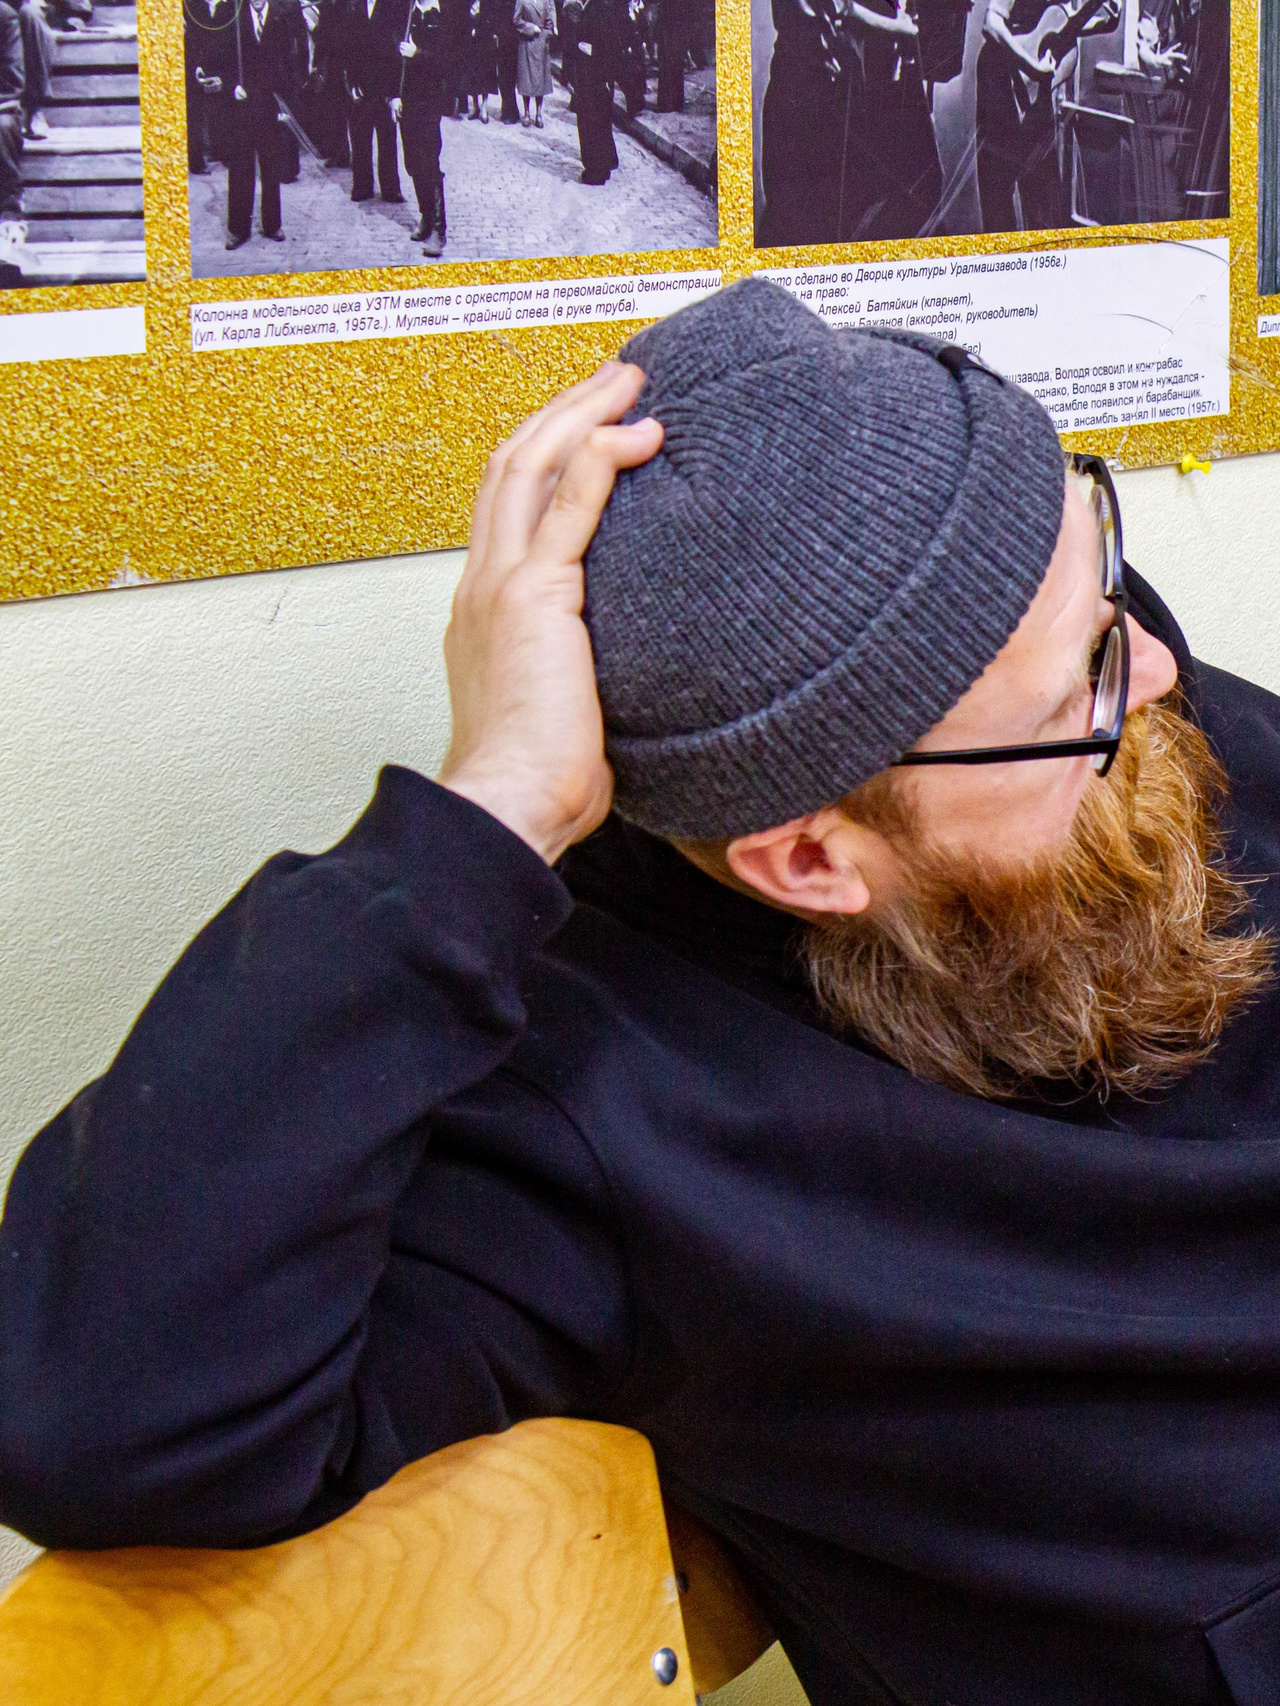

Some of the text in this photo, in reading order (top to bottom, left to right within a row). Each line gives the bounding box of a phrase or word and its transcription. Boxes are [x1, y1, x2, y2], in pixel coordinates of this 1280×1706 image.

[795, 272, 838, 286] сделано
[841, 272, 853, 282] во
[855, 269, 893, 283] Дворце
[896, 265, 947, 282] культуры
[950, 260, 1027, 278] Уралмашзавода
[1030, 255, 1066, 272] (1956г.)
[194, 277, 721, 322] Колонна модельного цеха УЗТМ вместе с оркестром на первомайской демонстрации
[800, 289, 813, 300] на
[815, 287, 850, 301] право:
[818, 293, 974, 315] Алексей Батяйкин (кларнет),
[195, 329, 218, 345] (ул.
[221, 327, 261, 342] Карла
[264, 322, 340, 337] Либхнехта,
[344, 316, 391, 331] 1957г.).
[396, 314, 449, 330] Мулявин
[463, 308, 512, 325] крайний
[516, 308, 548, 319] слева
[553, 304, 563, 320] (в
[566, 305, 591, 318] руке
[595, 298, 638, 315] труба).
[906, 311, 963, 328] (аккордеон,
[966, 304, 1038, 324] руководитель)
[1055, 367, 1090, 381] Володя
[1092, 364, 1125, 377] освоил
[1127, 363, 1134, 374] и
[1034, 386, 1069, 399] однако,
[1073, 383, 1107, 395] Володя
[1110, 382, 1114, 391] в
[1118, 380, 1138, 390] этом
[1156, 373, 1198, 388] нуждался
[1090, 396, 1134, 409] появился
[1146, 389, 1203, 404] барабанщик.
[1074, 413, 1119, 427] ансамбль
[1121, 410, 1149, 422] занял
[1159, 406, 1186, 417] место
[1188, 401, 1220, 416] (1957г.)
